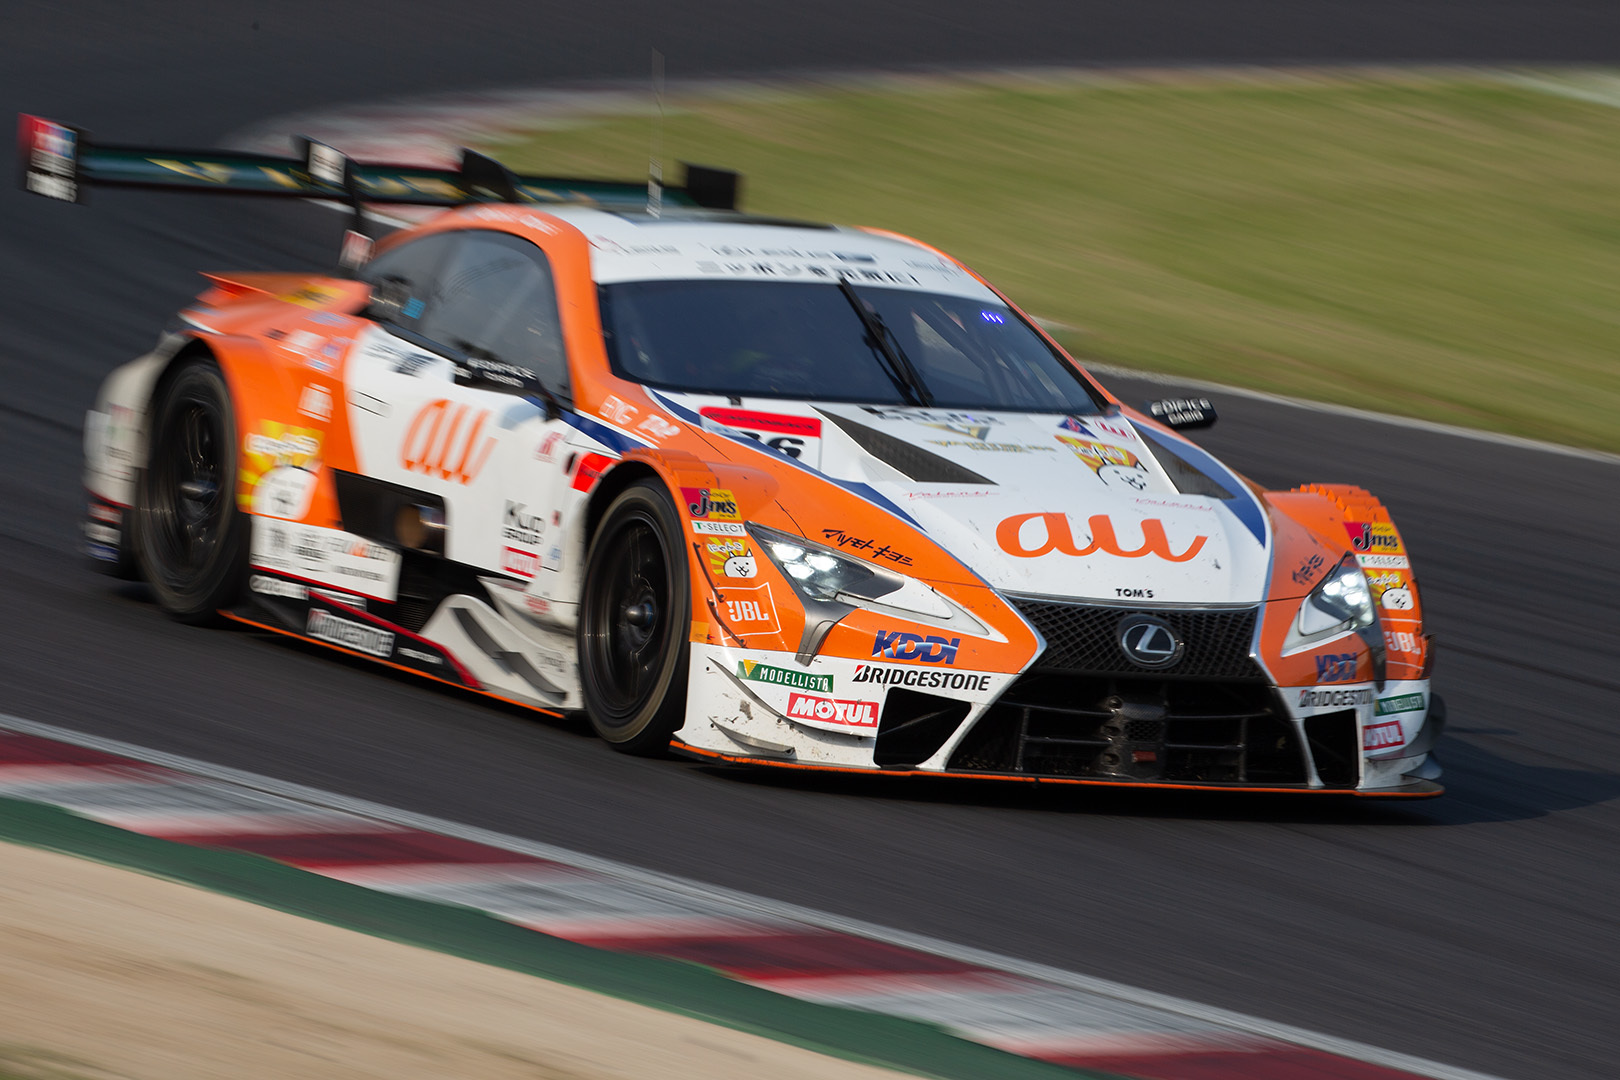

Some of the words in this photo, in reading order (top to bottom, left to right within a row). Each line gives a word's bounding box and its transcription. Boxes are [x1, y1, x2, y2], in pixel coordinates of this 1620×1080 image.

[694, 521, 744, 533] T-SELECT
[996, 512, 1208, 562] au
[727, 600, 770, 622] JBL
[872, 629, 961, 665] KDDI
[1384, 631, 1422, 654] JBL
[759, 666, 830, 691] MODELLISTA
[852, 664, 992, 692] BRIDGESTONE
[790, 696, 875, 725] MOTUL
